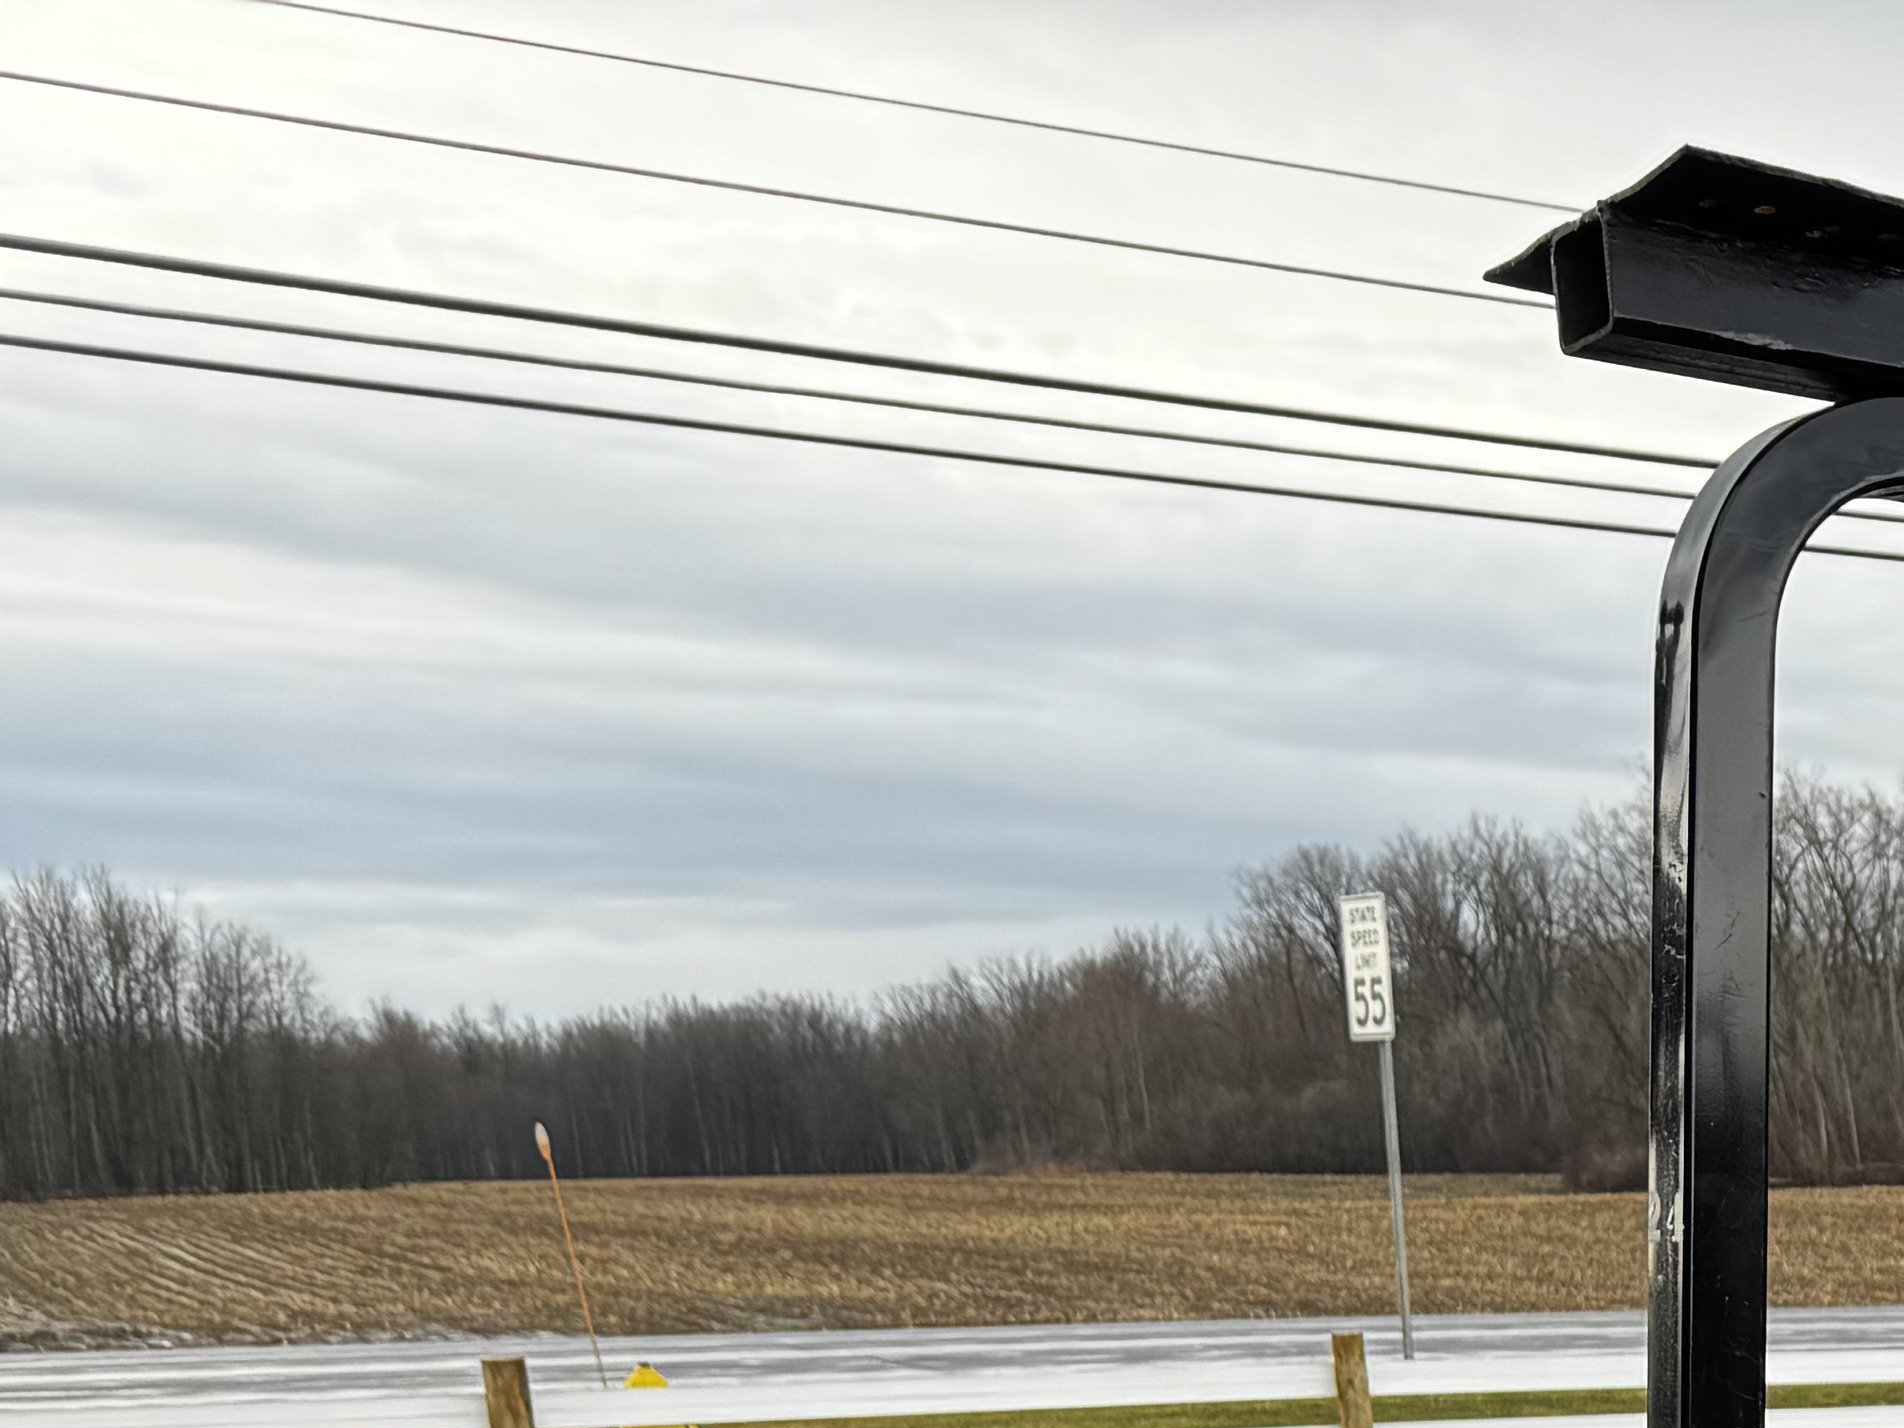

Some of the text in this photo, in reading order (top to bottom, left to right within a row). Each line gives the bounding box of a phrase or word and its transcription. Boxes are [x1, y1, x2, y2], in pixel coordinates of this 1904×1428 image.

[1348, 905, 1377, 925] STATE
[1350, 928, 1380, 948] SPEED
[1354, 951, 1378, 970] LIMIT
[1353, 976, 1387, 1027] 55
